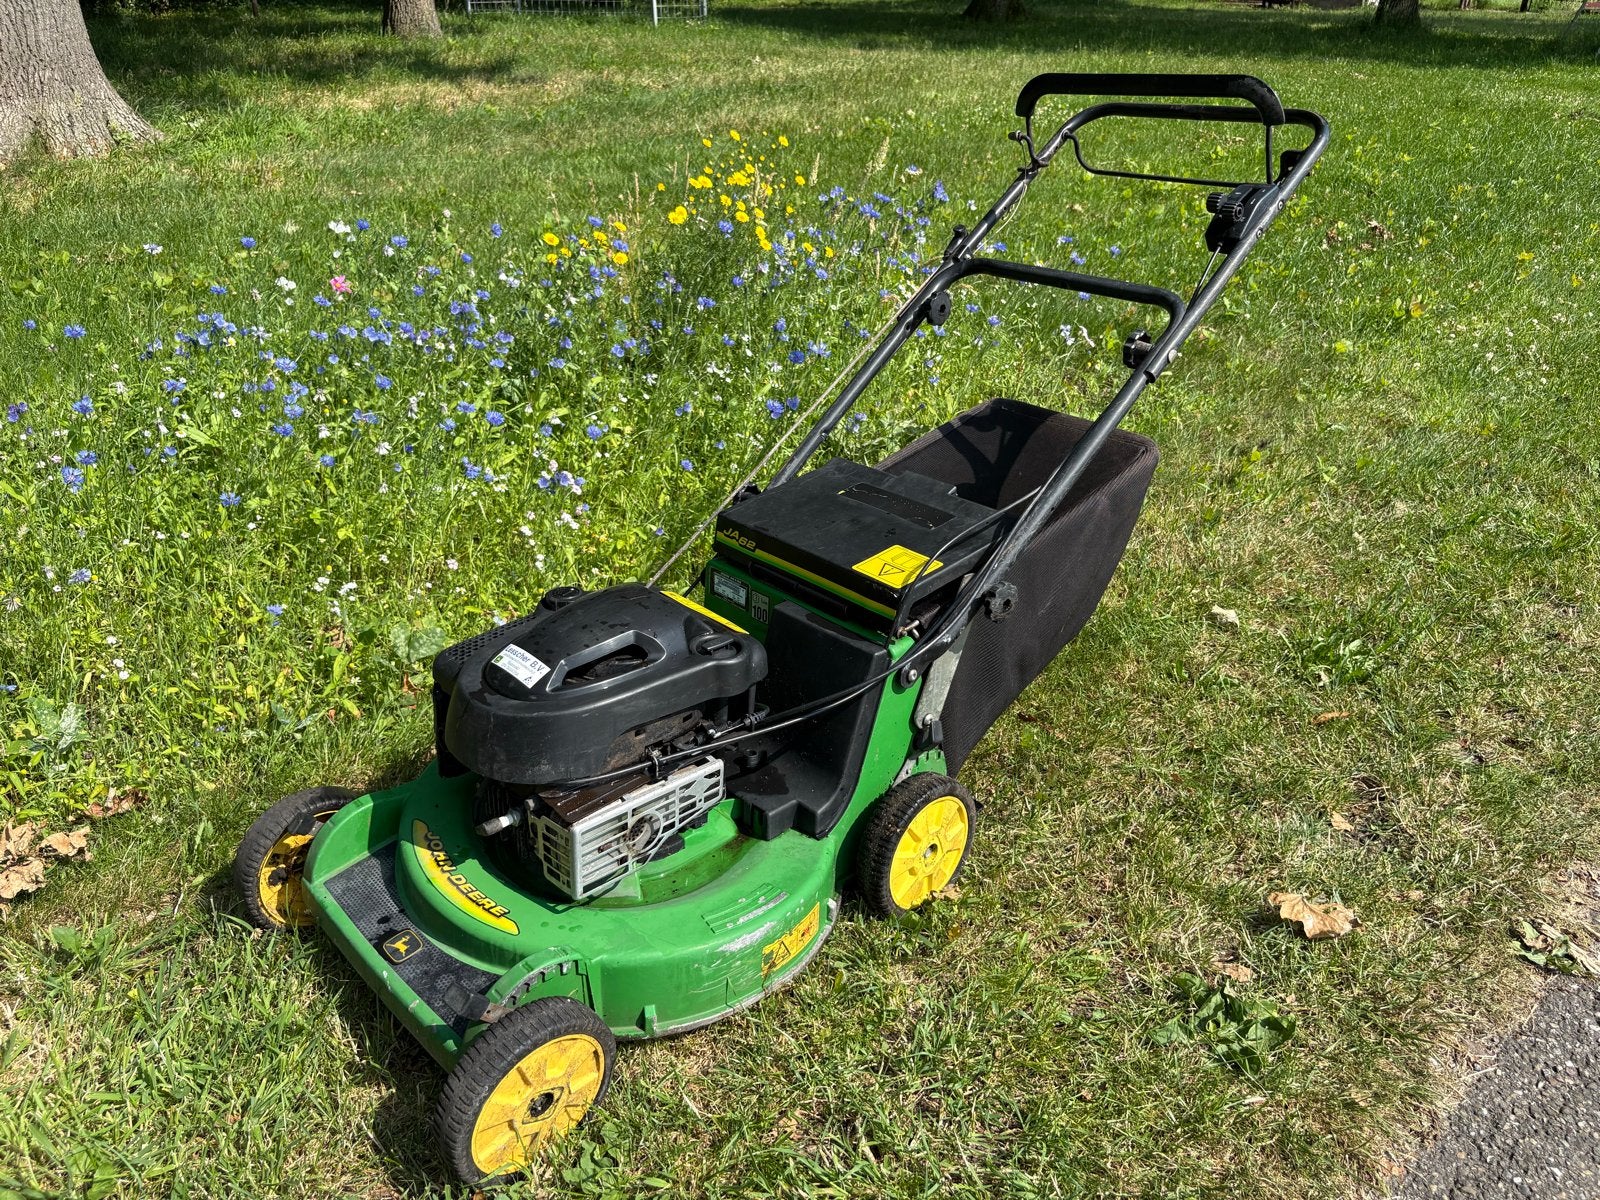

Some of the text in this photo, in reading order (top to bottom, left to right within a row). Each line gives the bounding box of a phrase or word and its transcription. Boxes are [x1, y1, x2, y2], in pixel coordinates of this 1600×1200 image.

[723, 527, 757, 550] JA62
[752, 604, 768, 624] 100
[426, 831, 511, 918] JOHN DEERE
